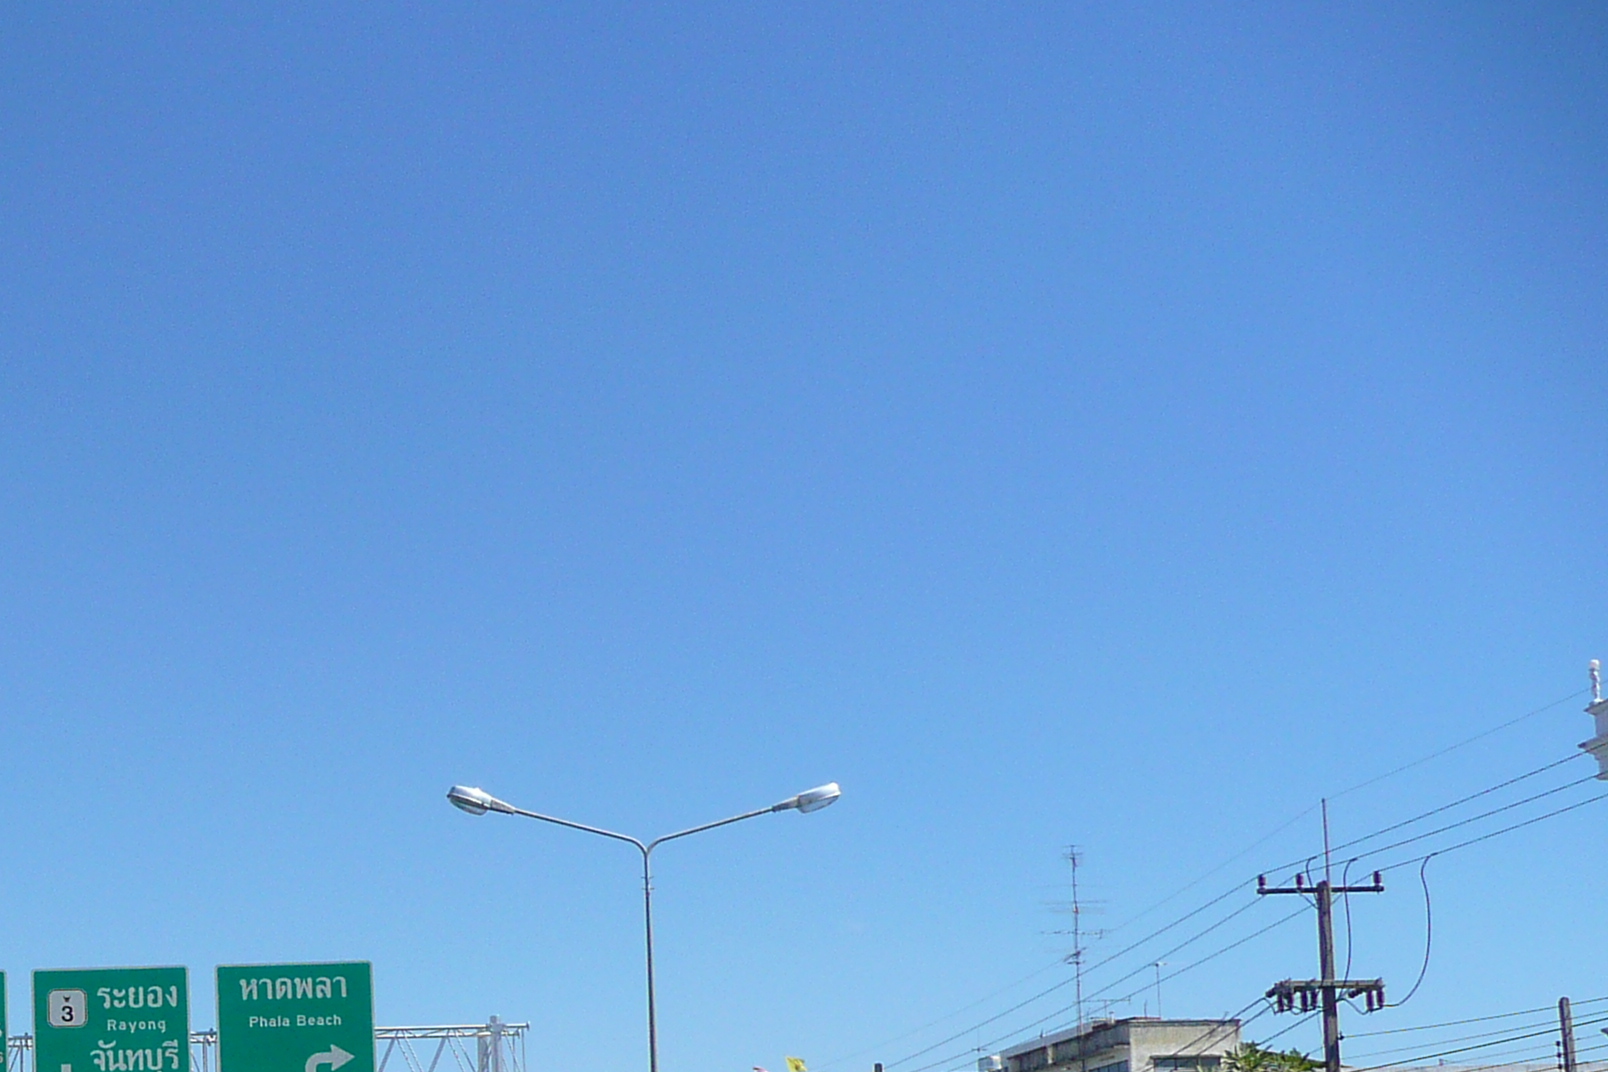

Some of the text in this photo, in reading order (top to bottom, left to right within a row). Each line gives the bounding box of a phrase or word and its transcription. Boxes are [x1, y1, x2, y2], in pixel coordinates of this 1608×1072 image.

[239, 976, 348, 1000] หาดพลา
[97, 985, 178, 1009] ระยอง
[61, 1006, 74, 1022] 3
[249, 1014, 341, 1027] Phala Beach
[107, 1019, 166, 1033] Rayong
